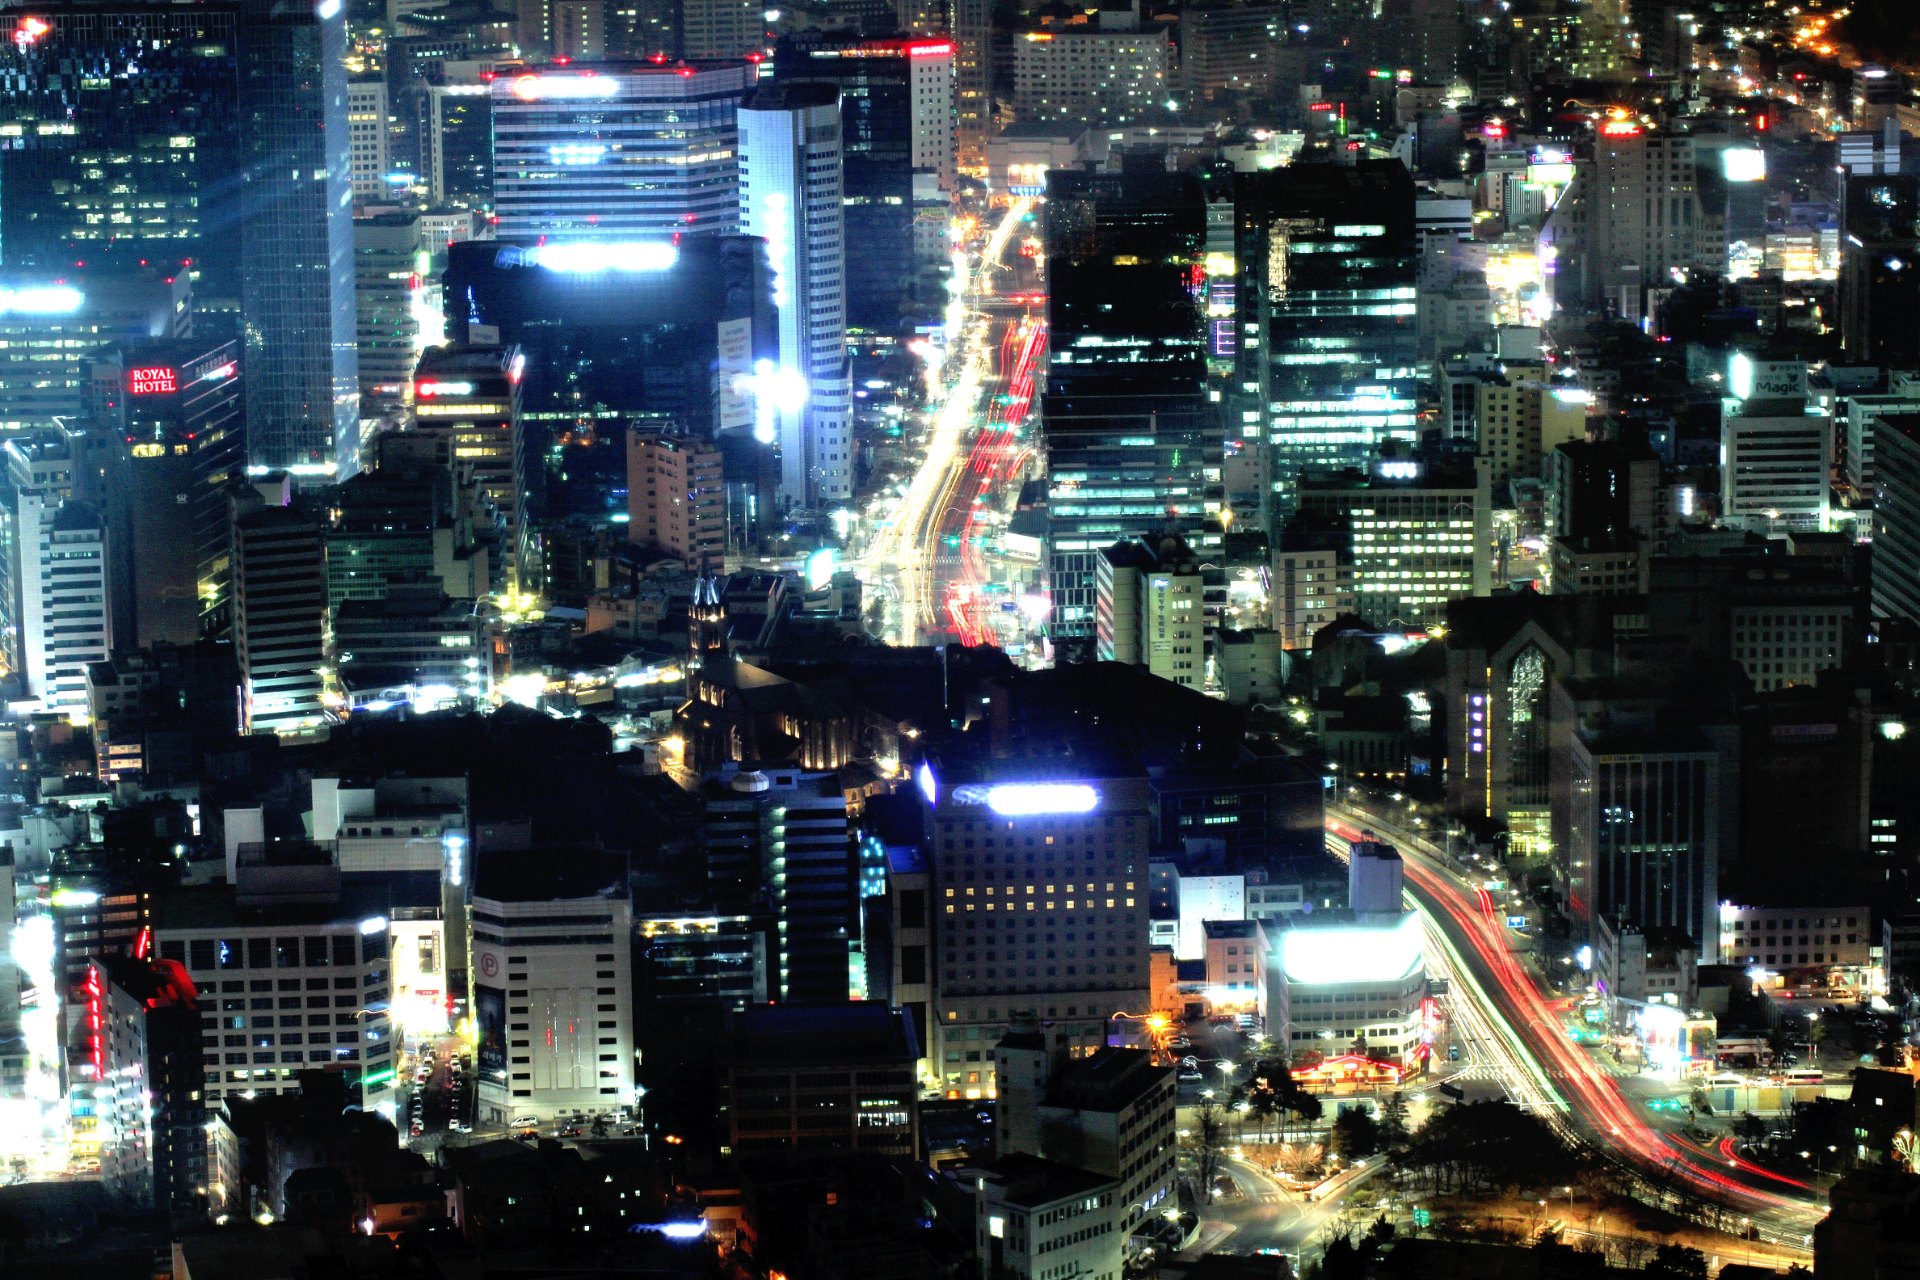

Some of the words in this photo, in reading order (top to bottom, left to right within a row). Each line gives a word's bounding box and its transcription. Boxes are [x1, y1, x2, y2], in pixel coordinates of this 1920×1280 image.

[16, 30, 35, 43] SK
[133, 369, 175, 381] ROYAL
[134, 381, 176, 393] HOTEL
[1755, 382, 1800, 395] Magic
